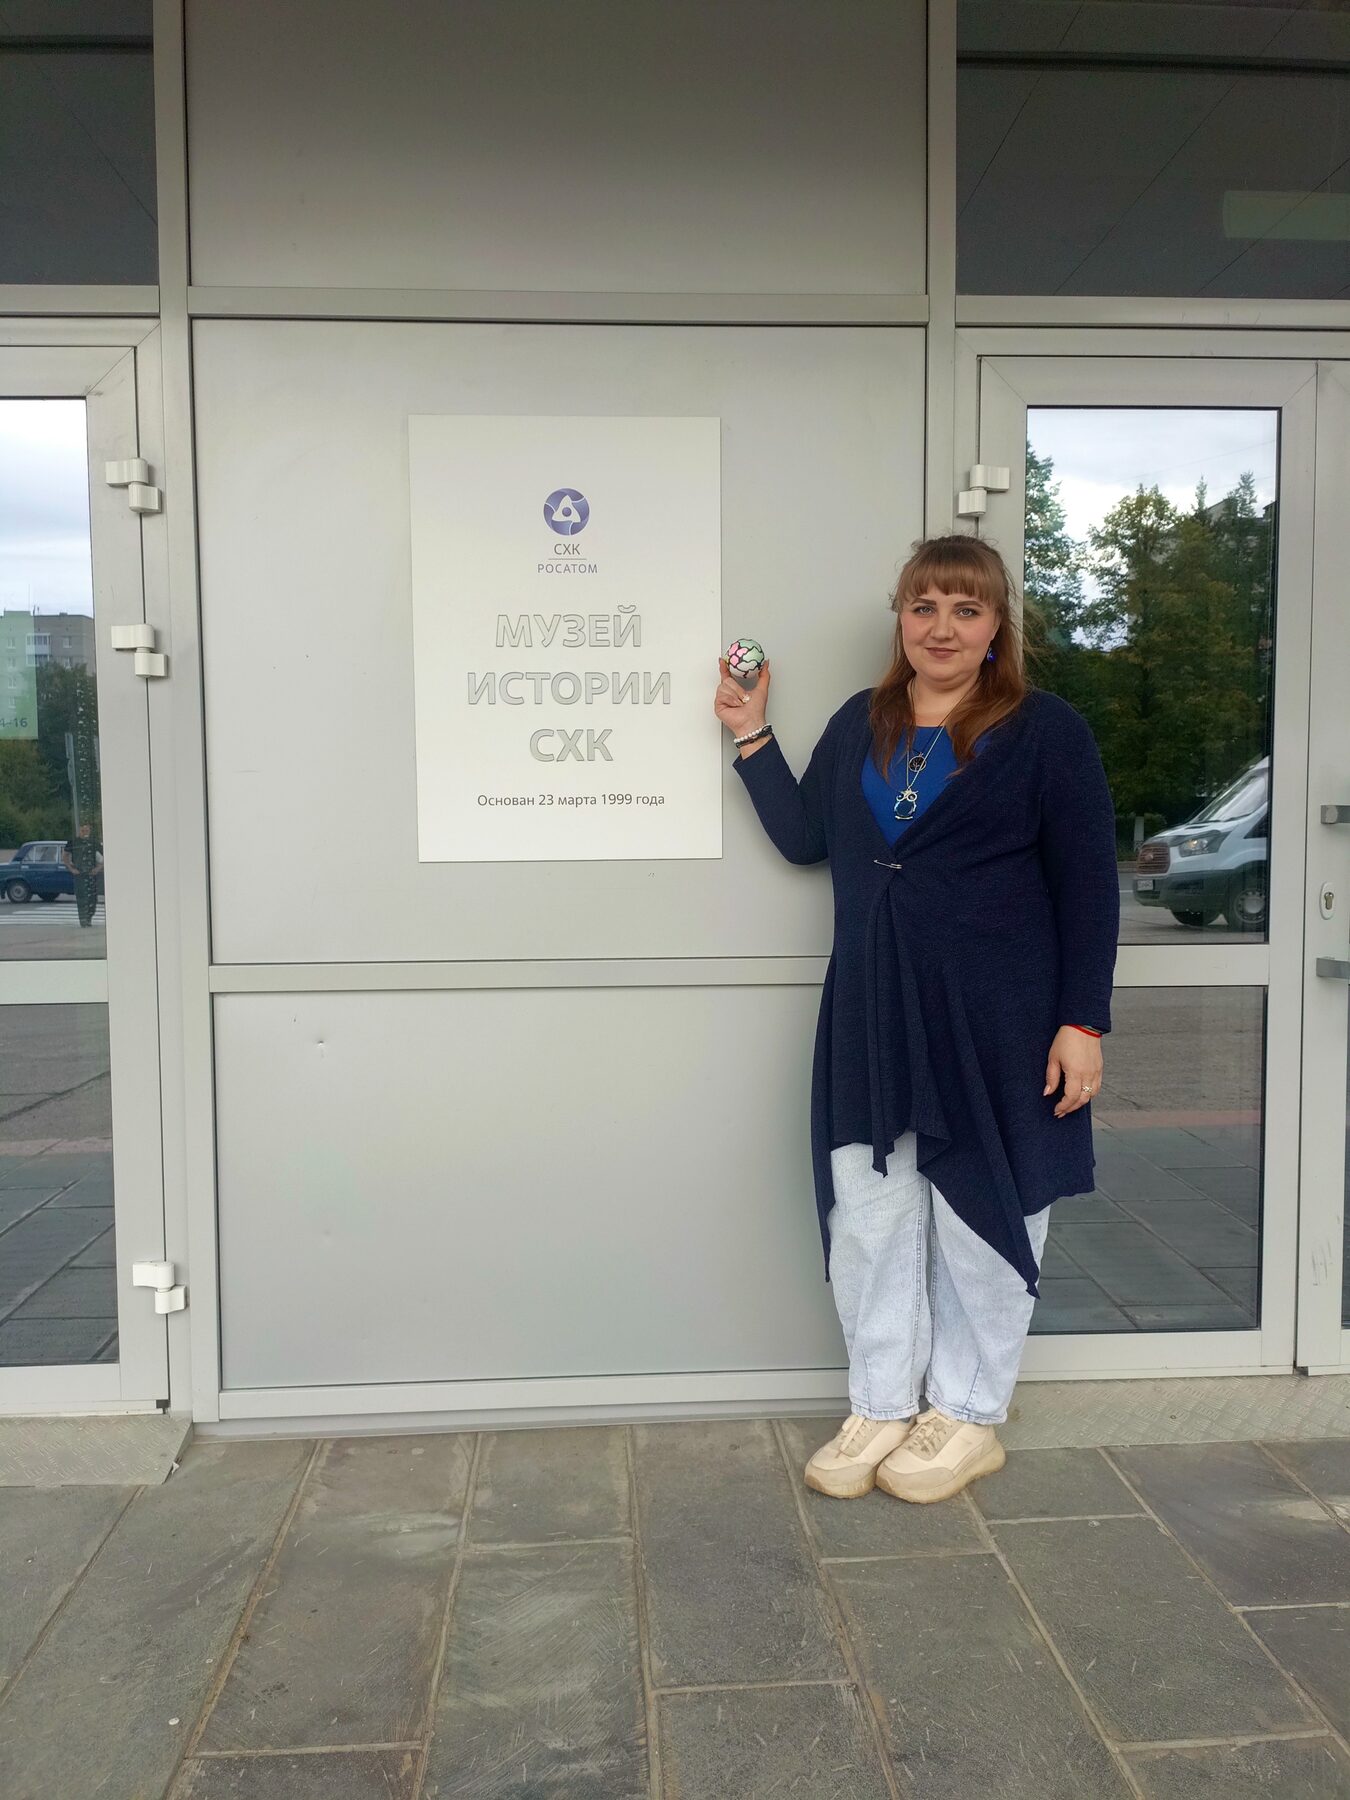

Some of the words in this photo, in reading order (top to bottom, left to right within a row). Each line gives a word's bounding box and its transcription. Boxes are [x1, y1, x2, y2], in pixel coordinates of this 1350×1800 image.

[553, 543, 581, 555] СХК
[537, 563, 598, 573] РОСАТОМ
[495, 604, 642, 648] МУЗЕЙ
[467, 672, 671, 705] ИСТОРИИ
[529, 729, 614, 762] СХК
[477, 795, 535, 806] Основан
[538, 794, 554, 806] 23
[558, 796, 597, 808] марта
[601, 793, 633, 805] 1999
[636, 796, 665, 806] года
